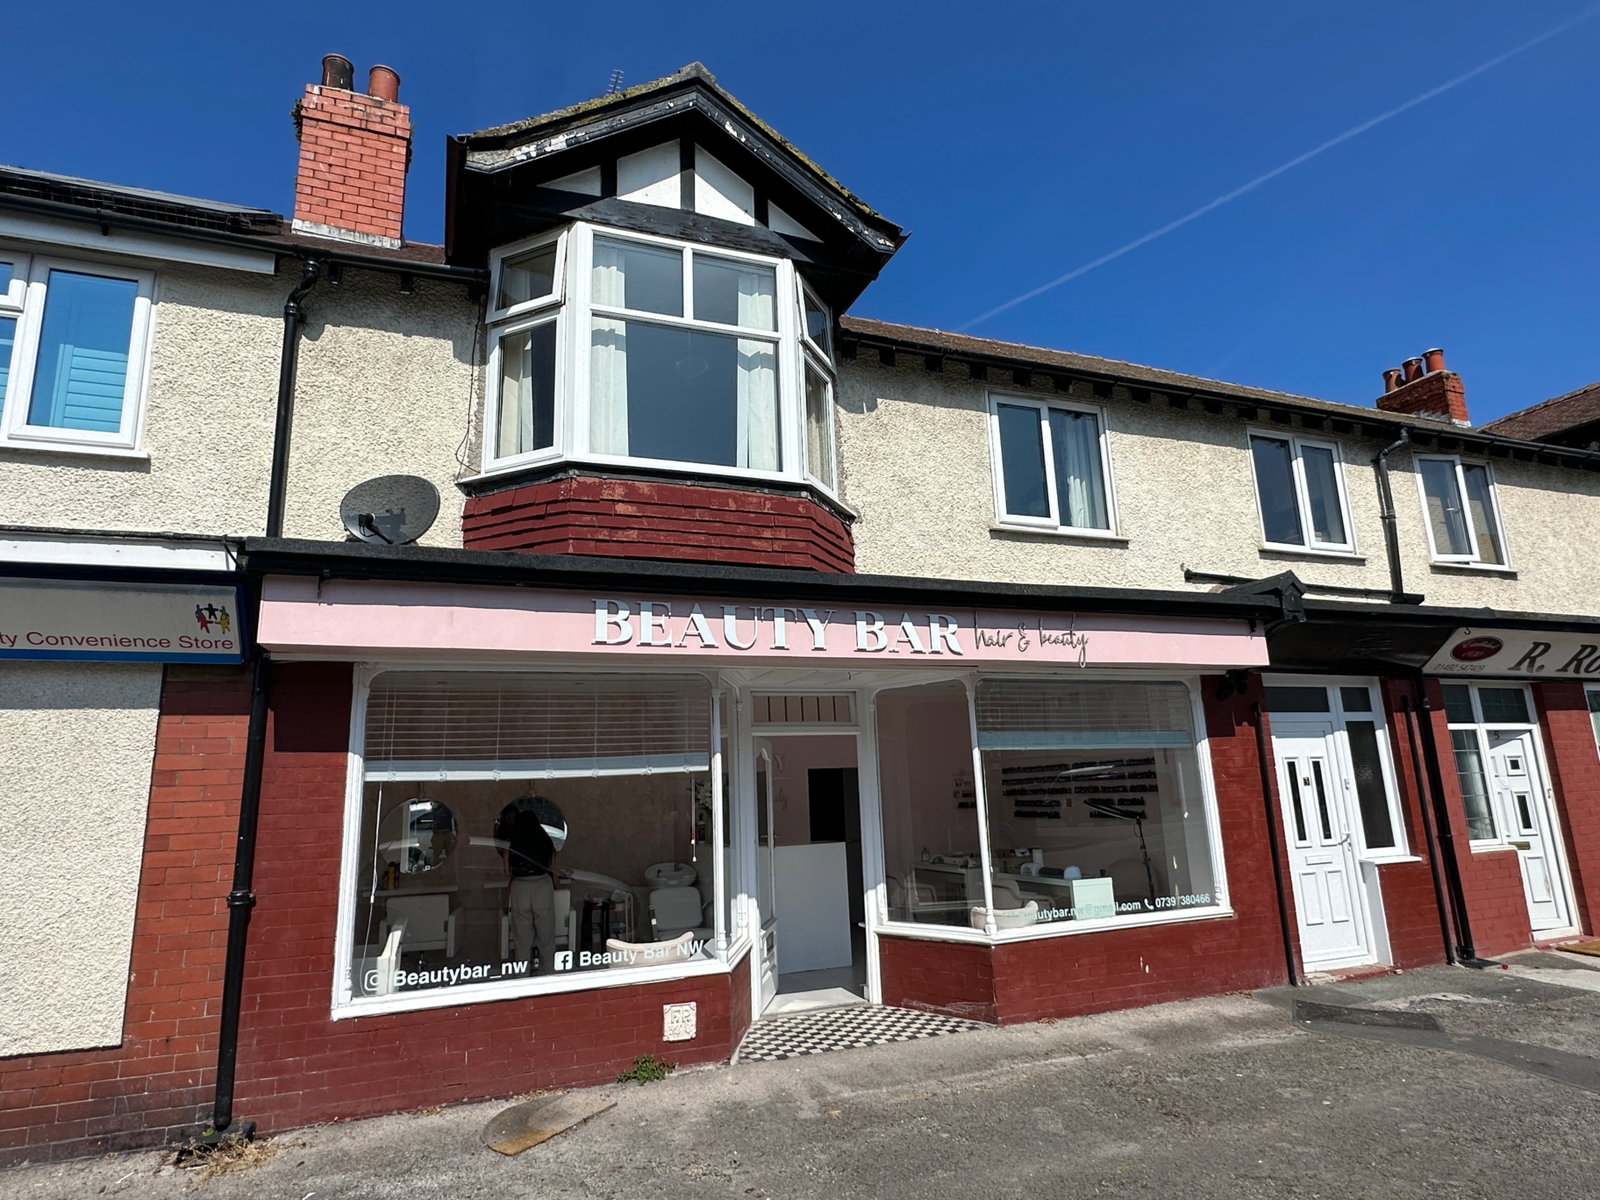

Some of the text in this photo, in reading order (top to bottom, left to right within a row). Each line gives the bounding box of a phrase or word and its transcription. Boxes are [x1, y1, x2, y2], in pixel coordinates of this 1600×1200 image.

[26, 631, 171, 649] Convenience
[178, 635, 233, 649] Store
[591, 598, 964, 656] BEAUTY BAR
[974, 611, 1089, 668] hair & beauty
[1507, 641, 1551, 673] R.
[579, 949, 638, 967] Beauty
[643, 944, 671, 960] Bar
[676, 939, 704, 957] NW
